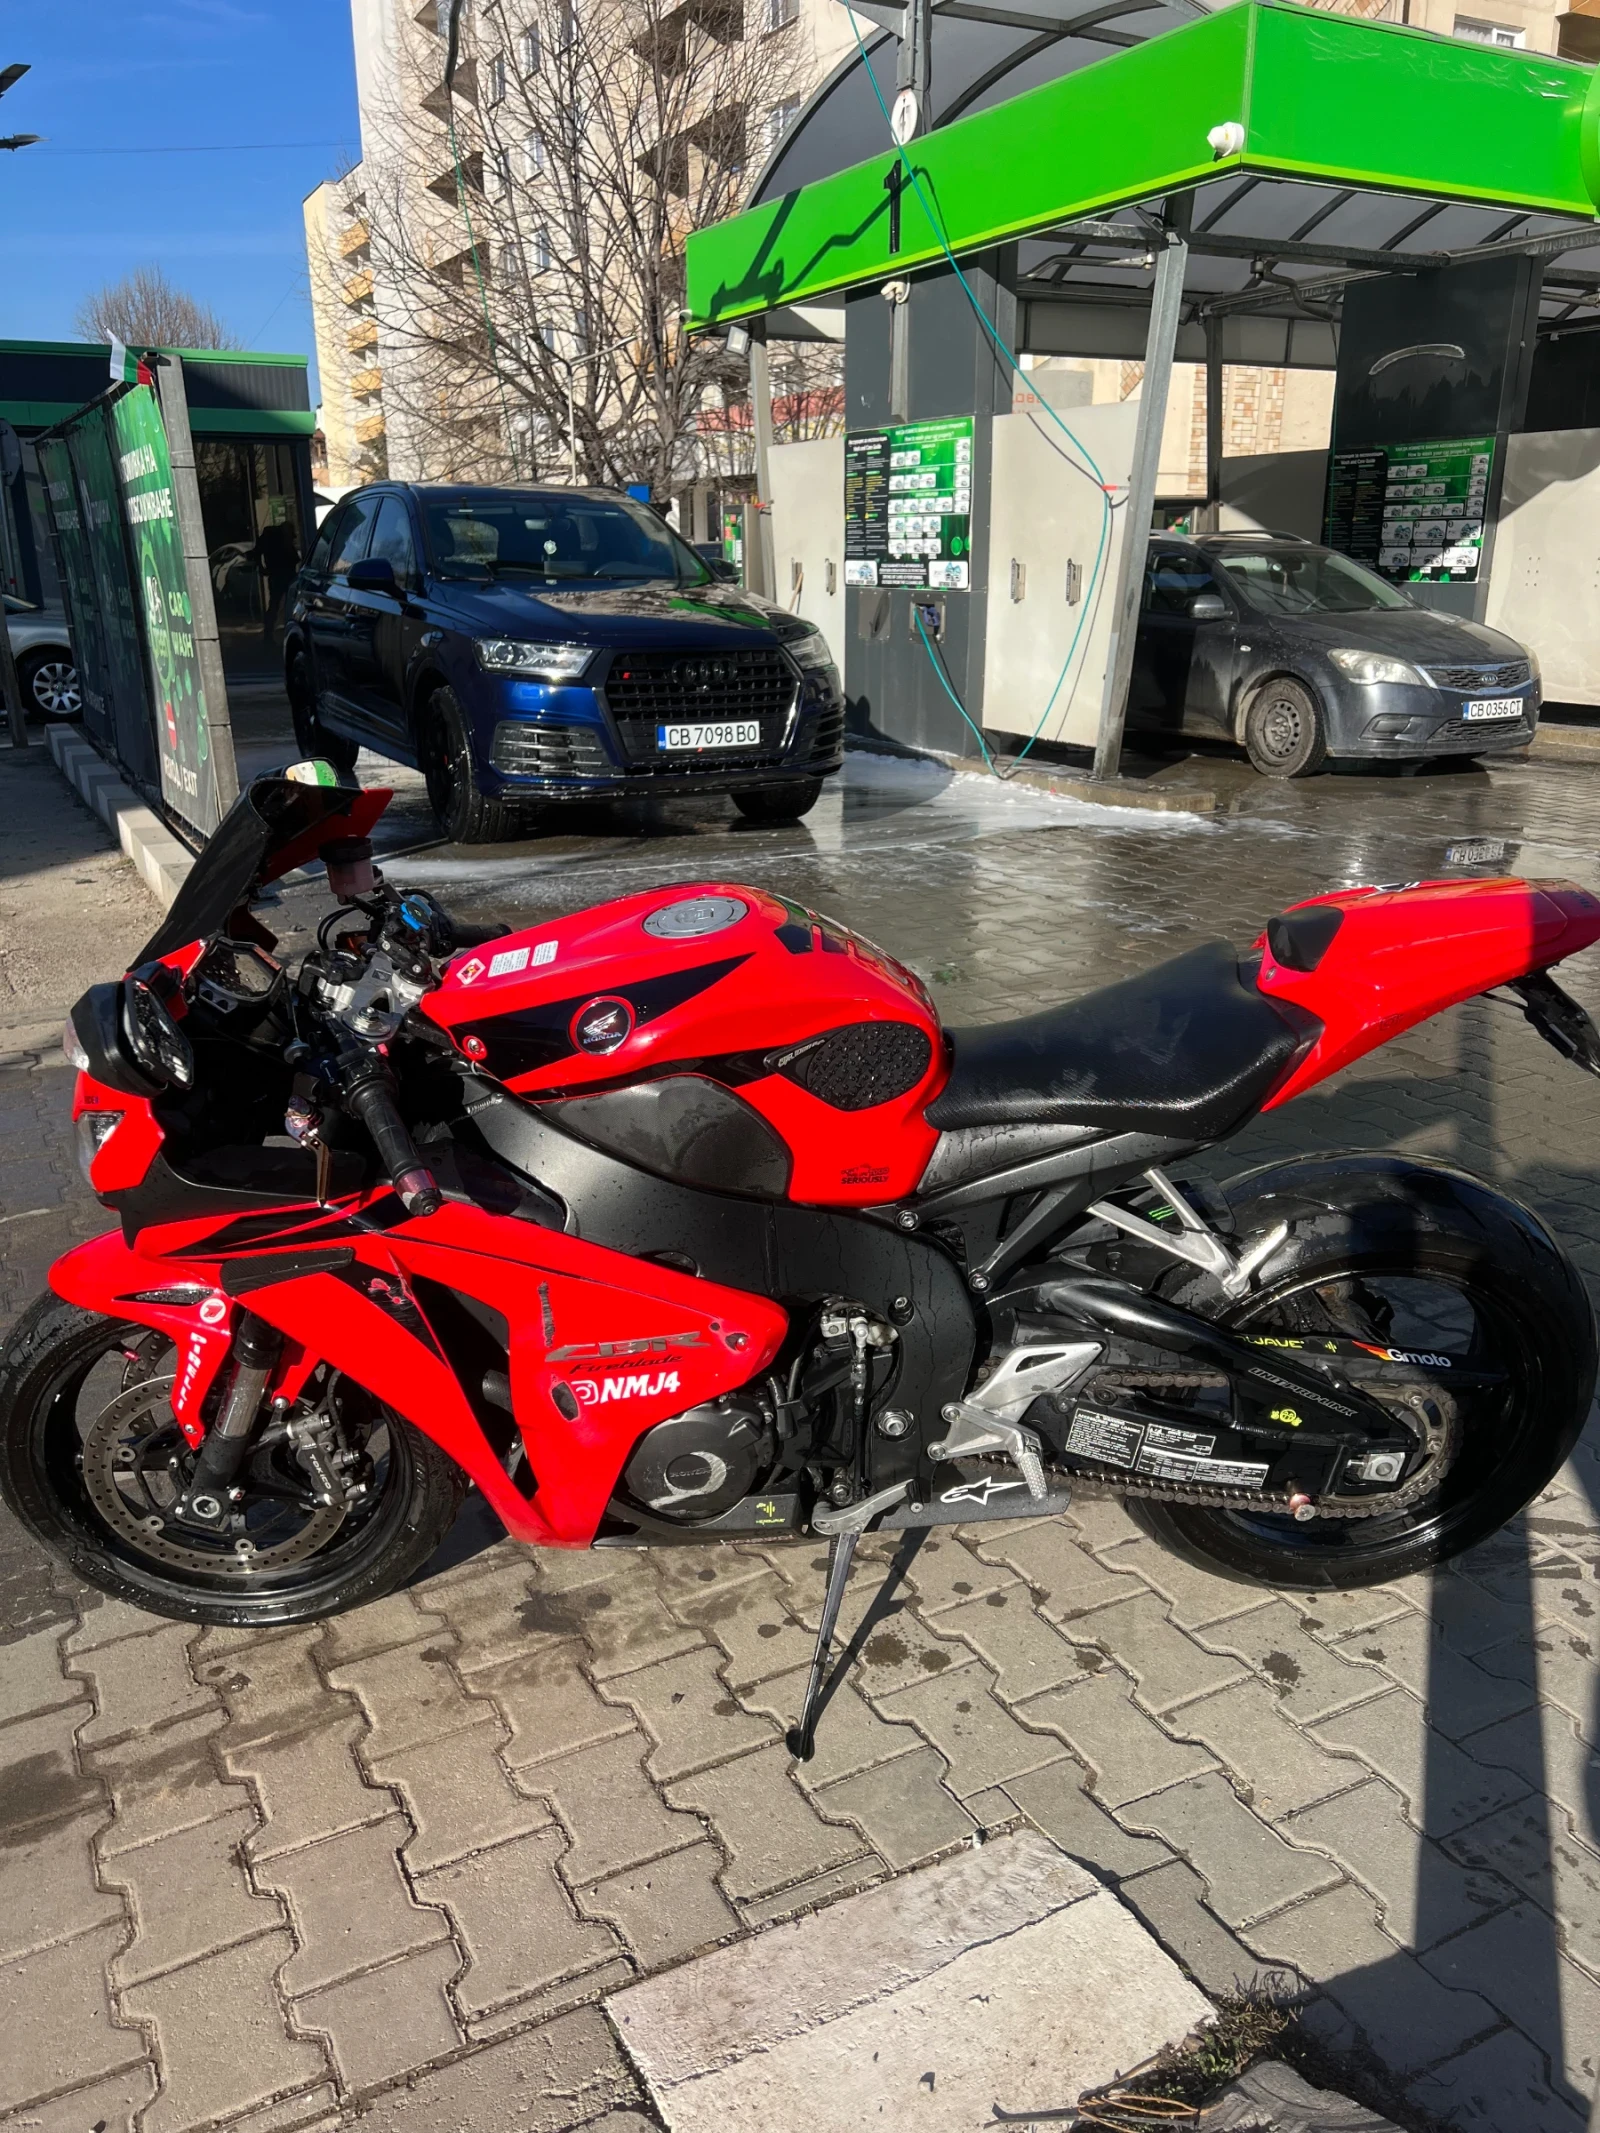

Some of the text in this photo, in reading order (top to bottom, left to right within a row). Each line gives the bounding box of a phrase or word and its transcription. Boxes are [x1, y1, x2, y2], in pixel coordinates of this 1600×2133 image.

[884, 159, 901, 254] 1
[171, 631, 194, 658] WASH
[1470, 704, 1484, 717] CB
[1486, 702, 1508, 716] 0356
[669, 728, 691, 746] CB
[694, 726, 733, 745] 7098
[736, 724, 757, 742] BO
[183, 766, 198, 798] EXIT
[583, 1032, 622, 1044] HONDA
[178, 1332, 207, 1410] PIRELLI
[569, 1355, 683, 1375] Fireblade
[1386, 1348, 1452, 1367] Gmoto
[600, 1371, 681, 1404] NMJ4
[310, 1453, 332, 1489] TOKICO
